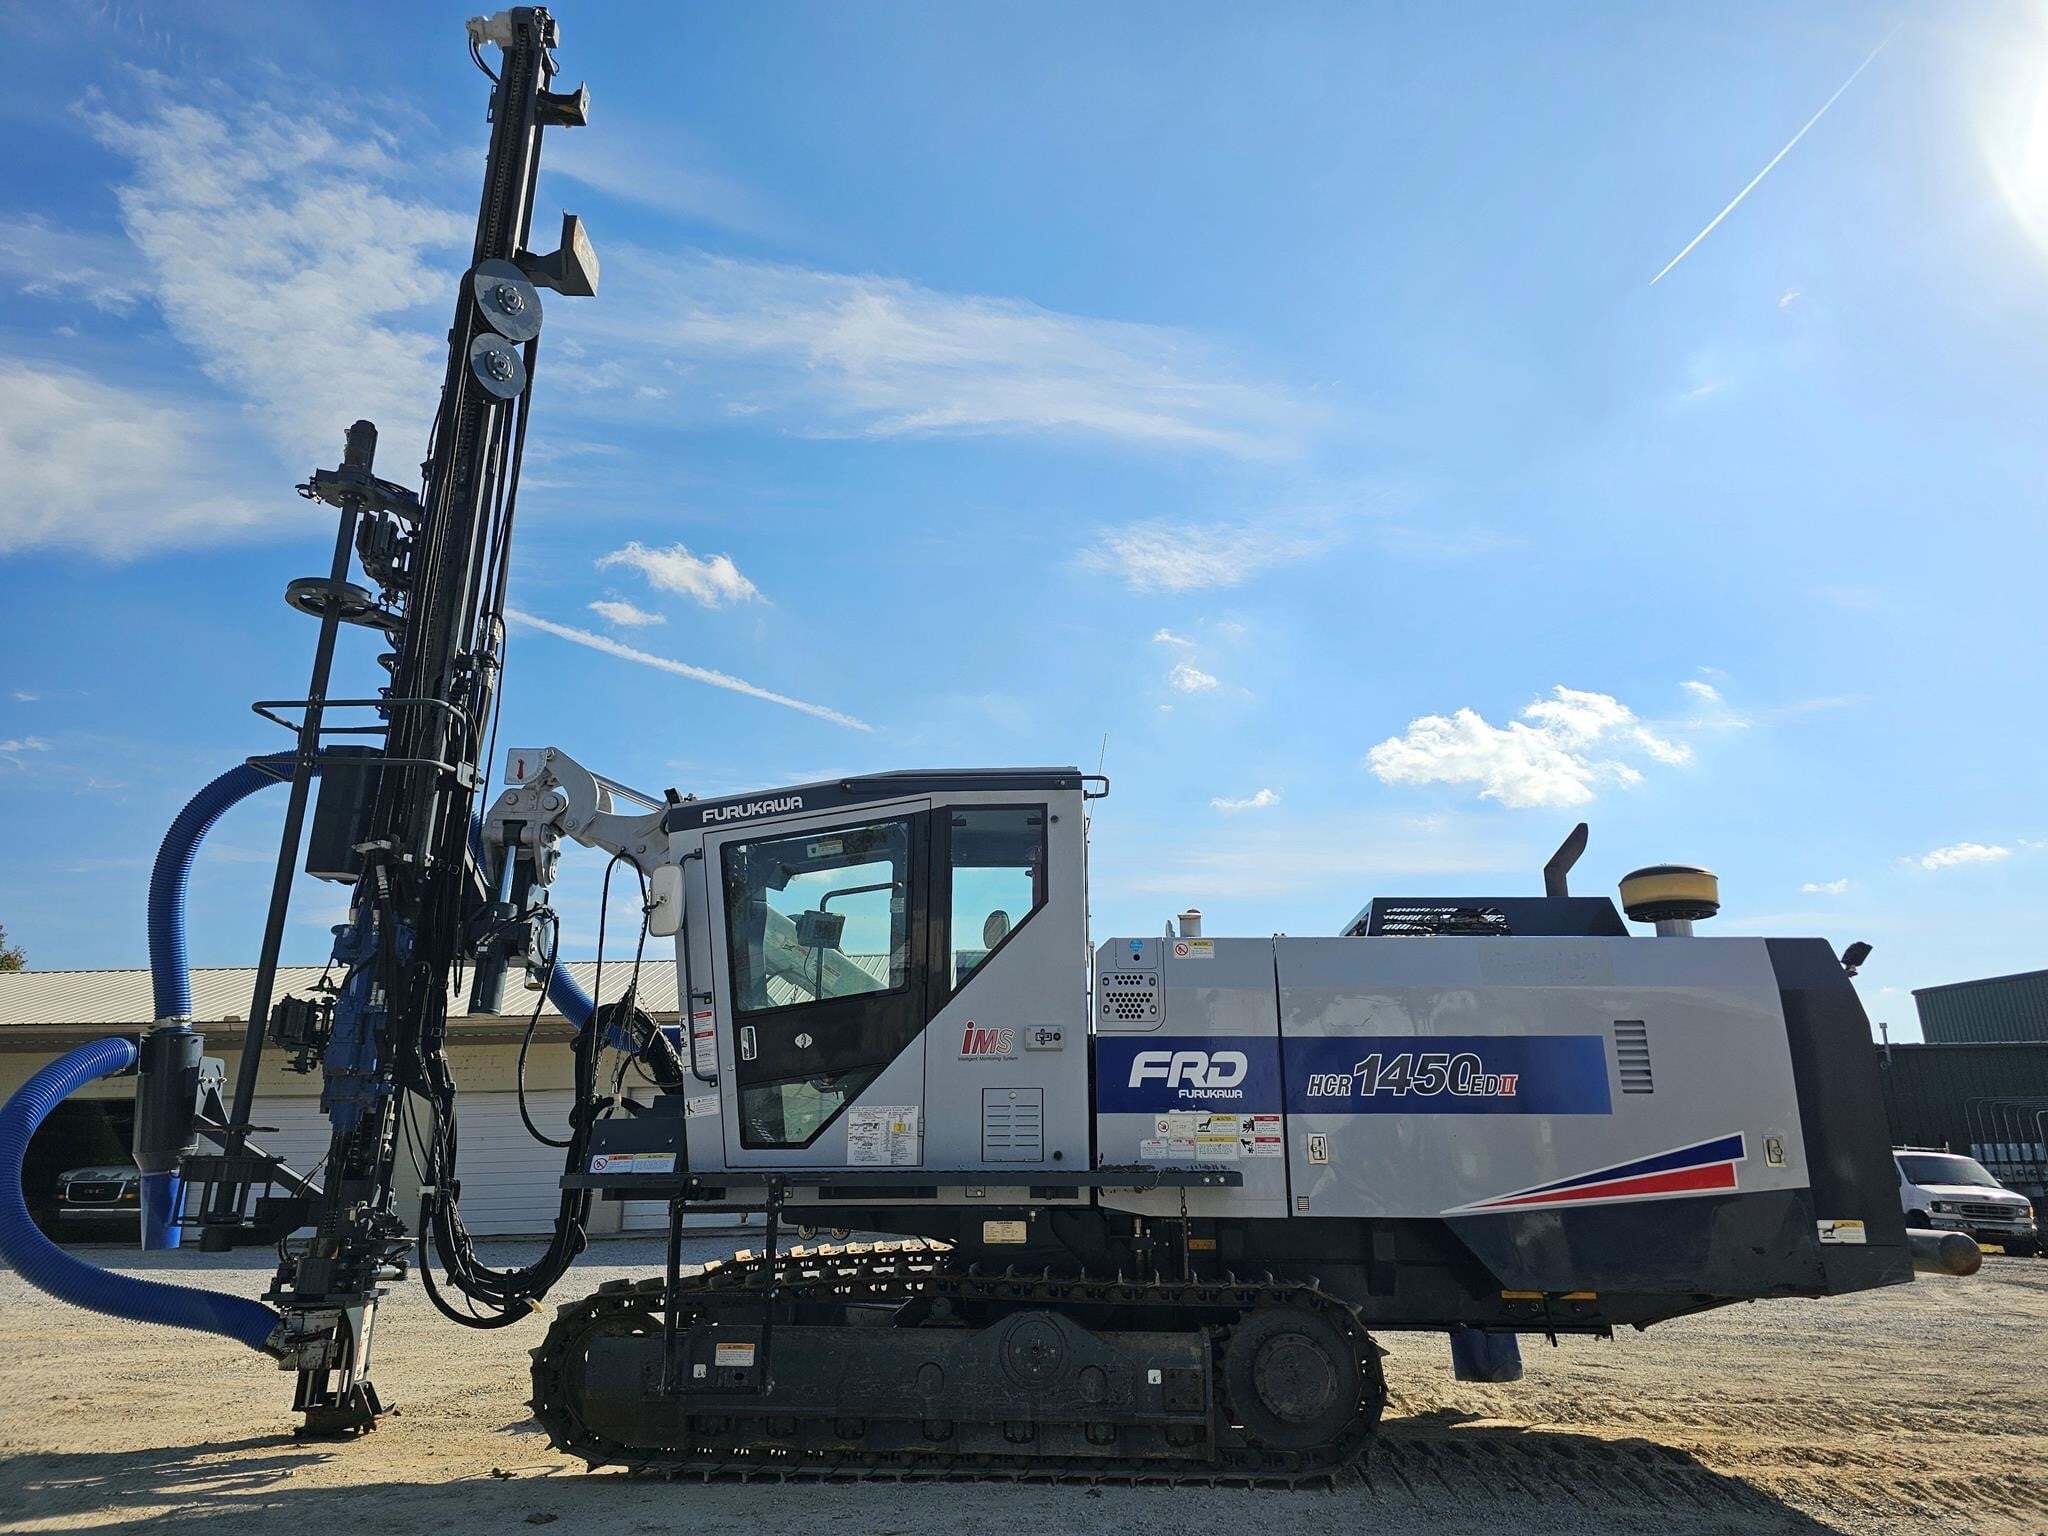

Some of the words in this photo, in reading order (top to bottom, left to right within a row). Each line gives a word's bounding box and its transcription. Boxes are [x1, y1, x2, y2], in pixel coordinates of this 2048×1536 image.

[702, 796, 803, 823] FURUKAWA
[1128, 1051, 1248, 1088] FRD
[1178, 1089, 1243, 1099] FURUKAWA
